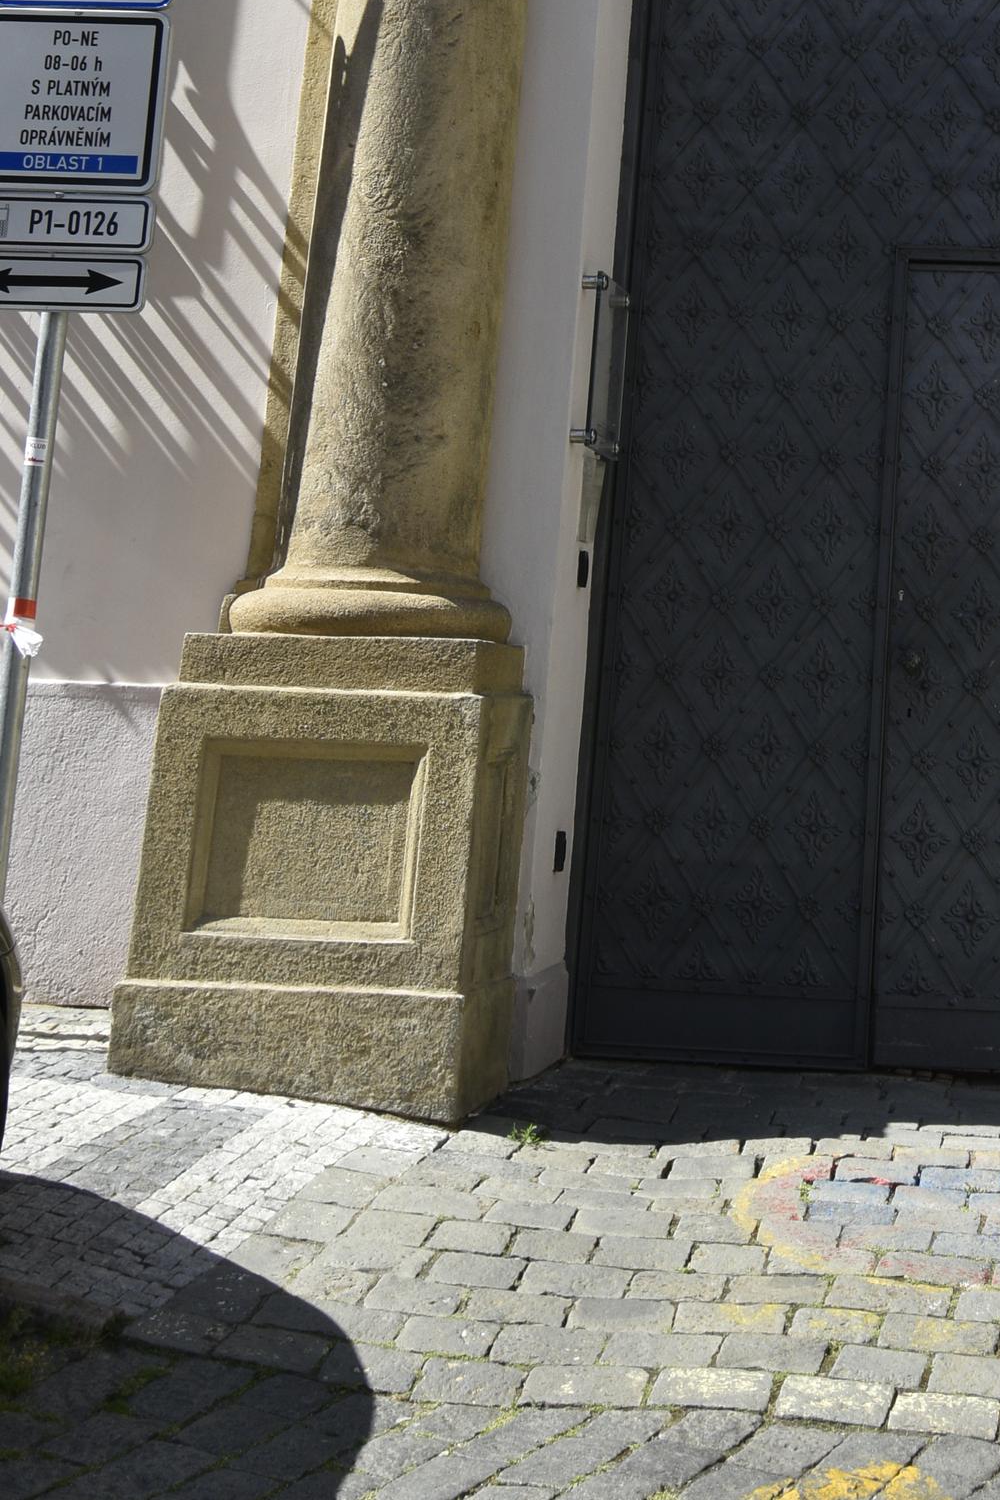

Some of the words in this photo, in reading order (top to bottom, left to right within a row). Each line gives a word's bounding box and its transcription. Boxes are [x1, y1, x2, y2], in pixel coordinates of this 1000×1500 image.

[53, 30, 99, 47] PO-NE
[44, 55, 87, 71] 08-06
[94, 56, 102, 72] h
[31, 79, 40, 95] S
[47, 77, 111, 97] PLATNÝM
[24, 102, 112, 122] PARKOVACÍM
[19, 126, 111, 148] OPRÁVNĚNÍM
[22, 155, 90, 171] OBLAST
[97, 157, 103, 171] 1
[28, 209, 119, 237] P1-0126
